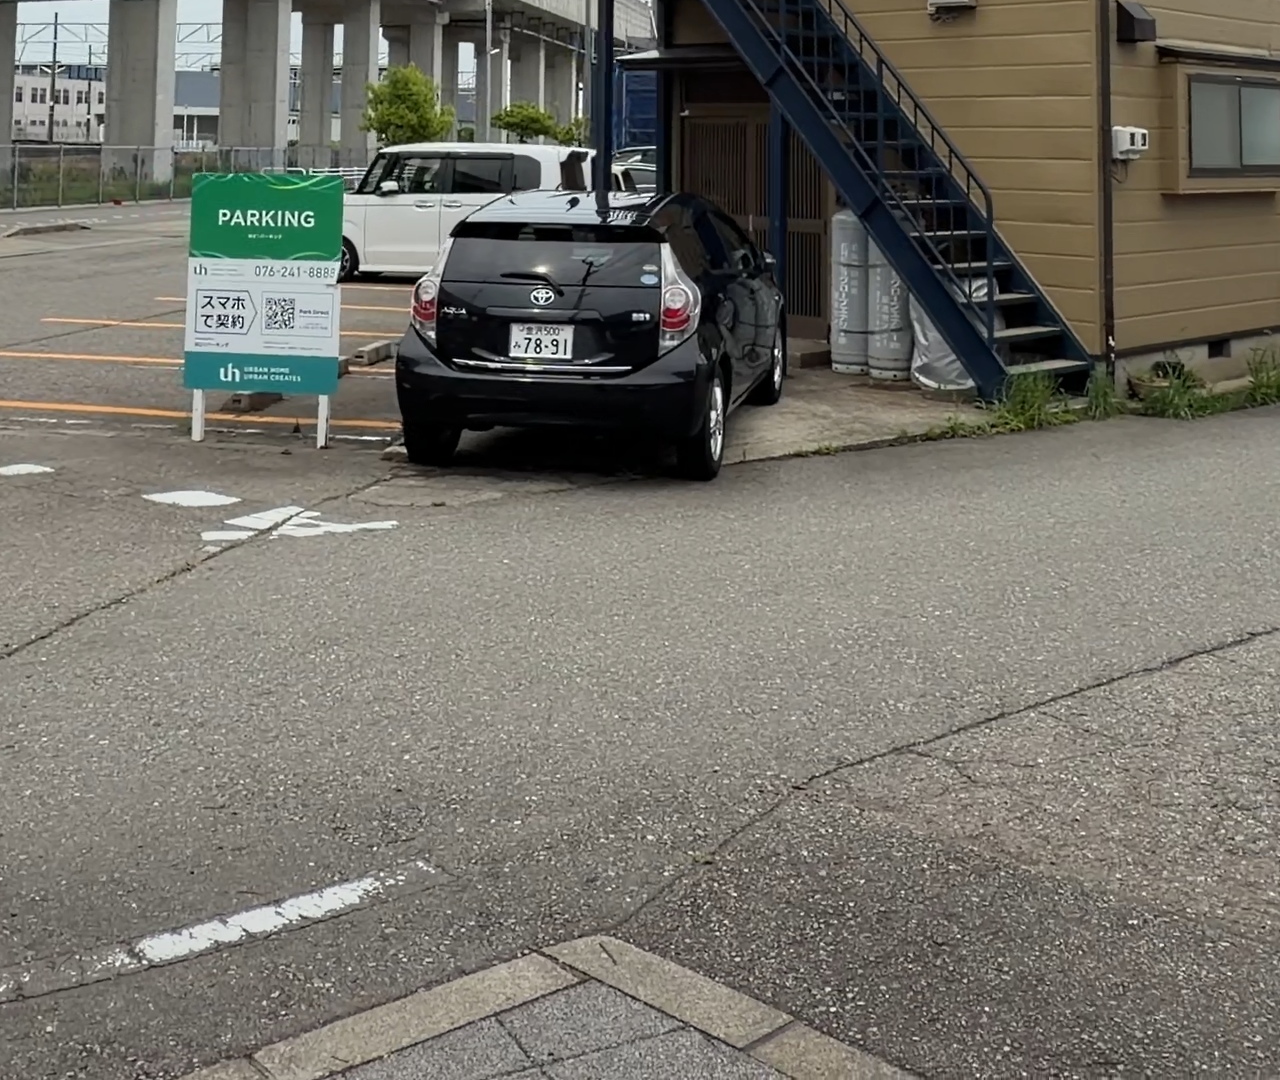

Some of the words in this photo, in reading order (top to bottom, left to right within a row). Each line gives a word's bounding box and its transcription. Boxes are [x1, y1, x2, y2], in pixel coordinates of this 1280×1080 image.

[218, 209, 315, 228] PARKING
[201, 295, 246, 311] スマホ
[200, 314, 245, 330] で契約
[524, 337, 567, 356] 78-91
[243, 373, 269, 381] URBAN
[269, 374, 302, 382] CREATES
